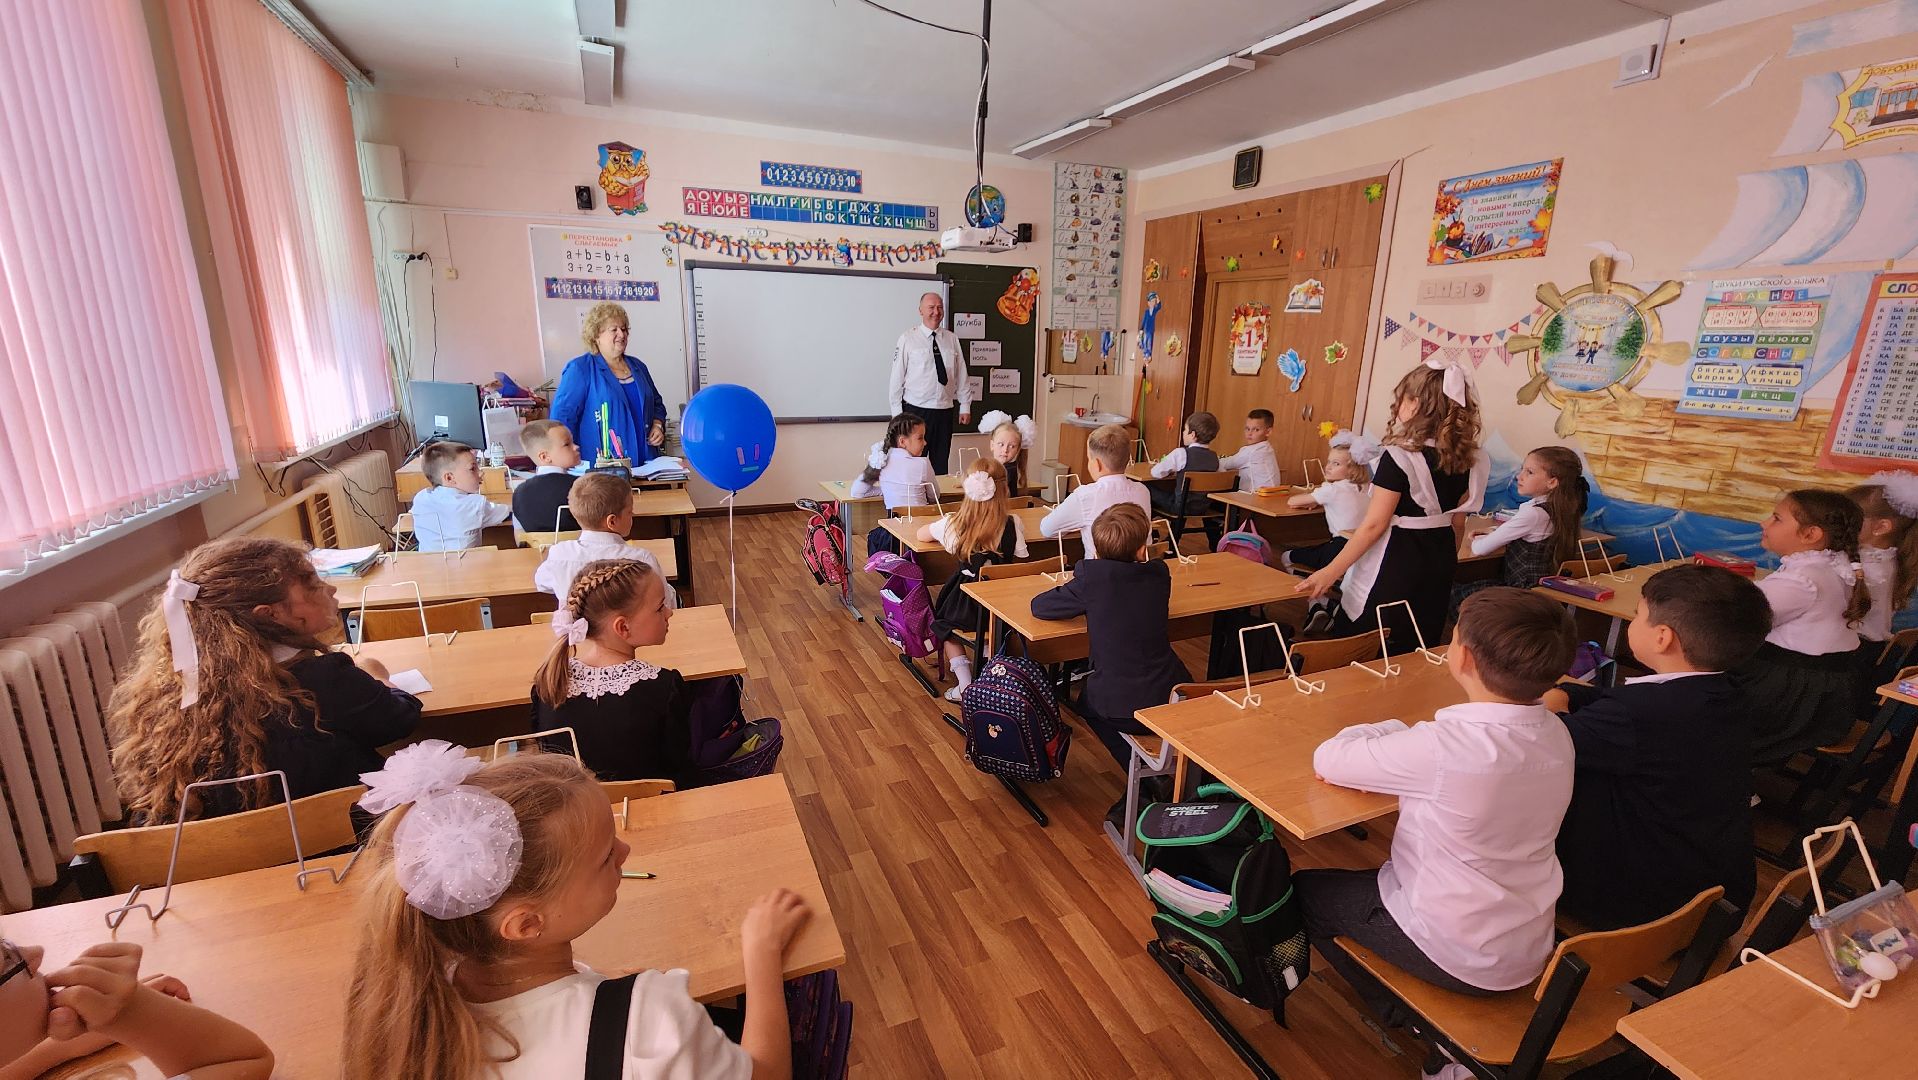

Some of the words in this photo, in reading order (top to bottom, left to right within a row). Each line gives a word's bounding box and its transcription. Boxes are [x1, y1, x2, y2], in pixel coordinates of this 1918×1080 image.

[1495, 165, 1546, 184] знаний!
[1245, 329, 1253, 348] 1
[1164, 804, 1220, 812] MONSTER
[1168, 809, 1209, 817] STEEL
